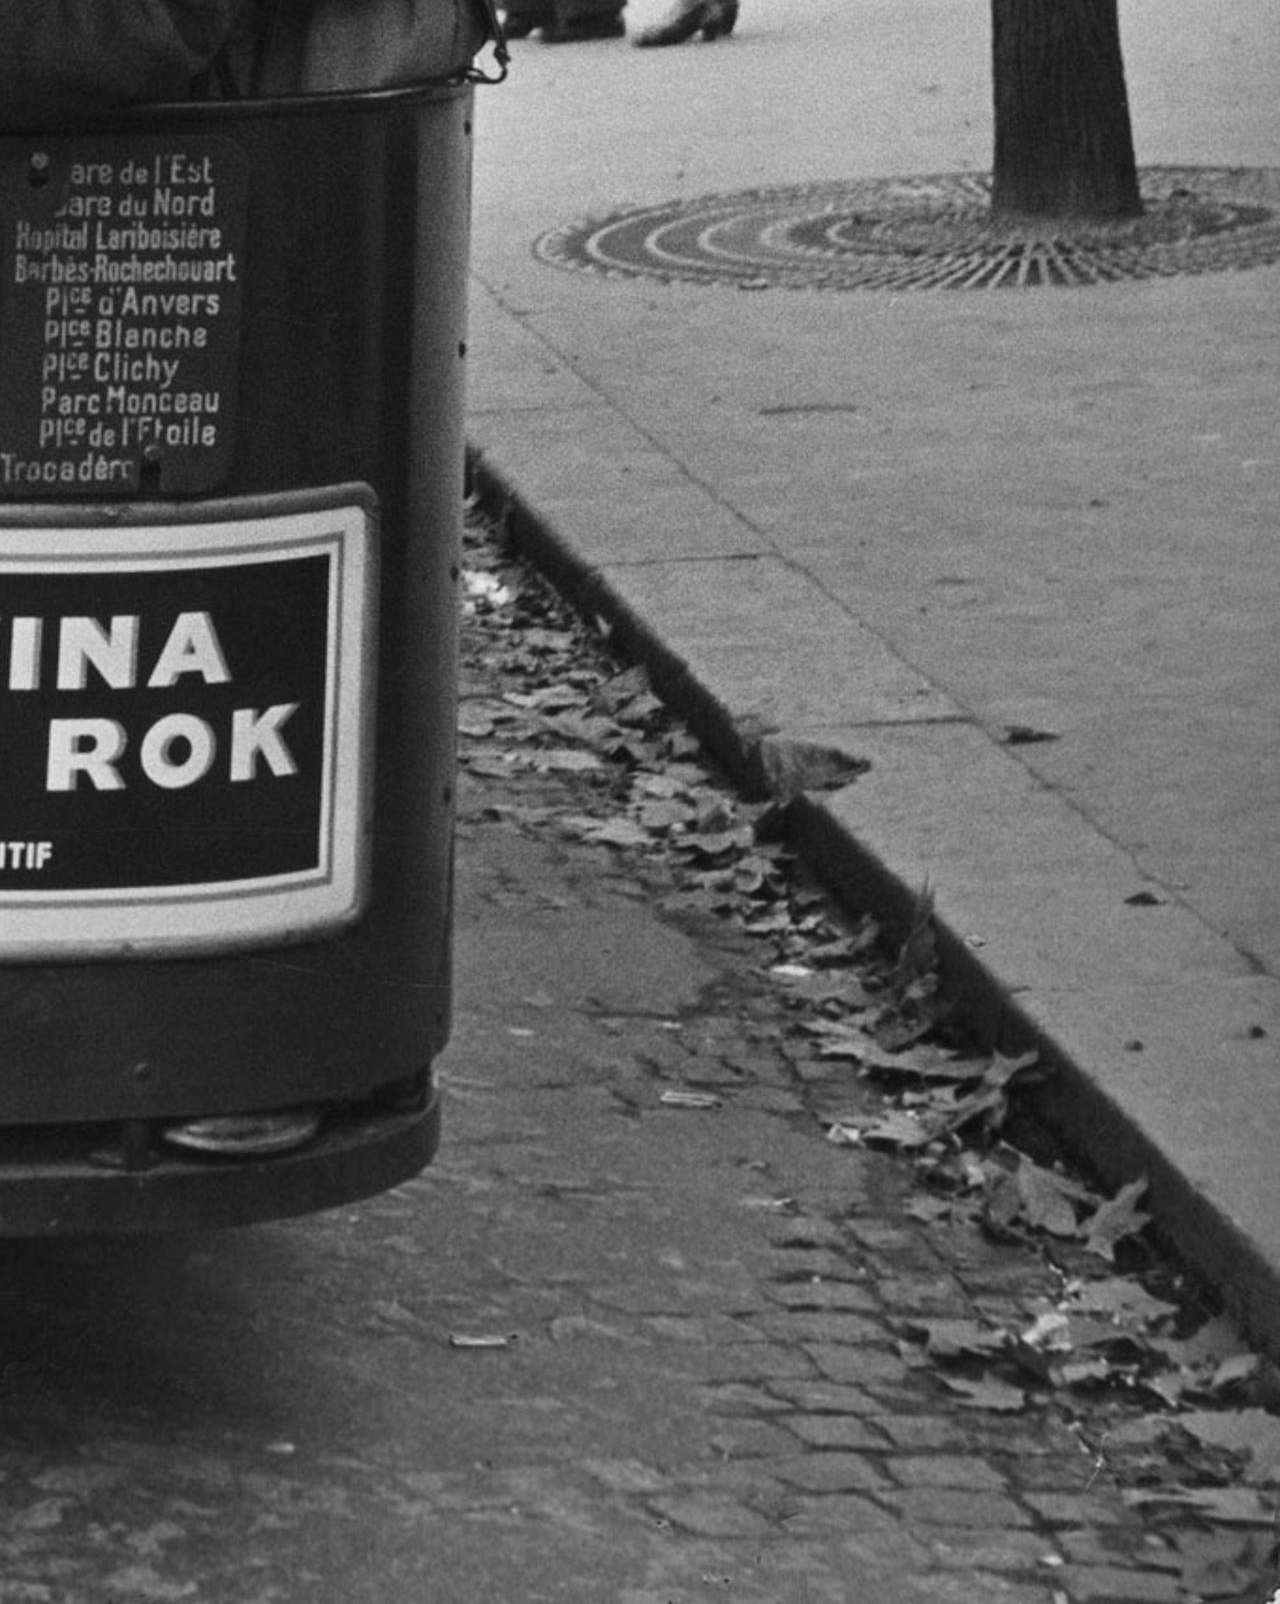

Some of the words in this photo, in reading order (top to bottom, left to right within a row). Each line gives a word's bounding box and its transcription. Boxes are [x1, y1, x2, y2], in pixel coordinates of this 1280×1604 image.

[69, 161, 113, 186] are
[120, 160, 149, 185] de
[118, 190, 149, 217] du
[153, 188, 215, 217] Nord
[95, 319, 207, 349] Blanche
[94, 351, 179, 390] Clichy
[40, 386, 100, 415] Parc
[105, 385, 221, 414] Monceau
[89, 422, 117, 447] de
[45, 701, 301, 791] ROK
